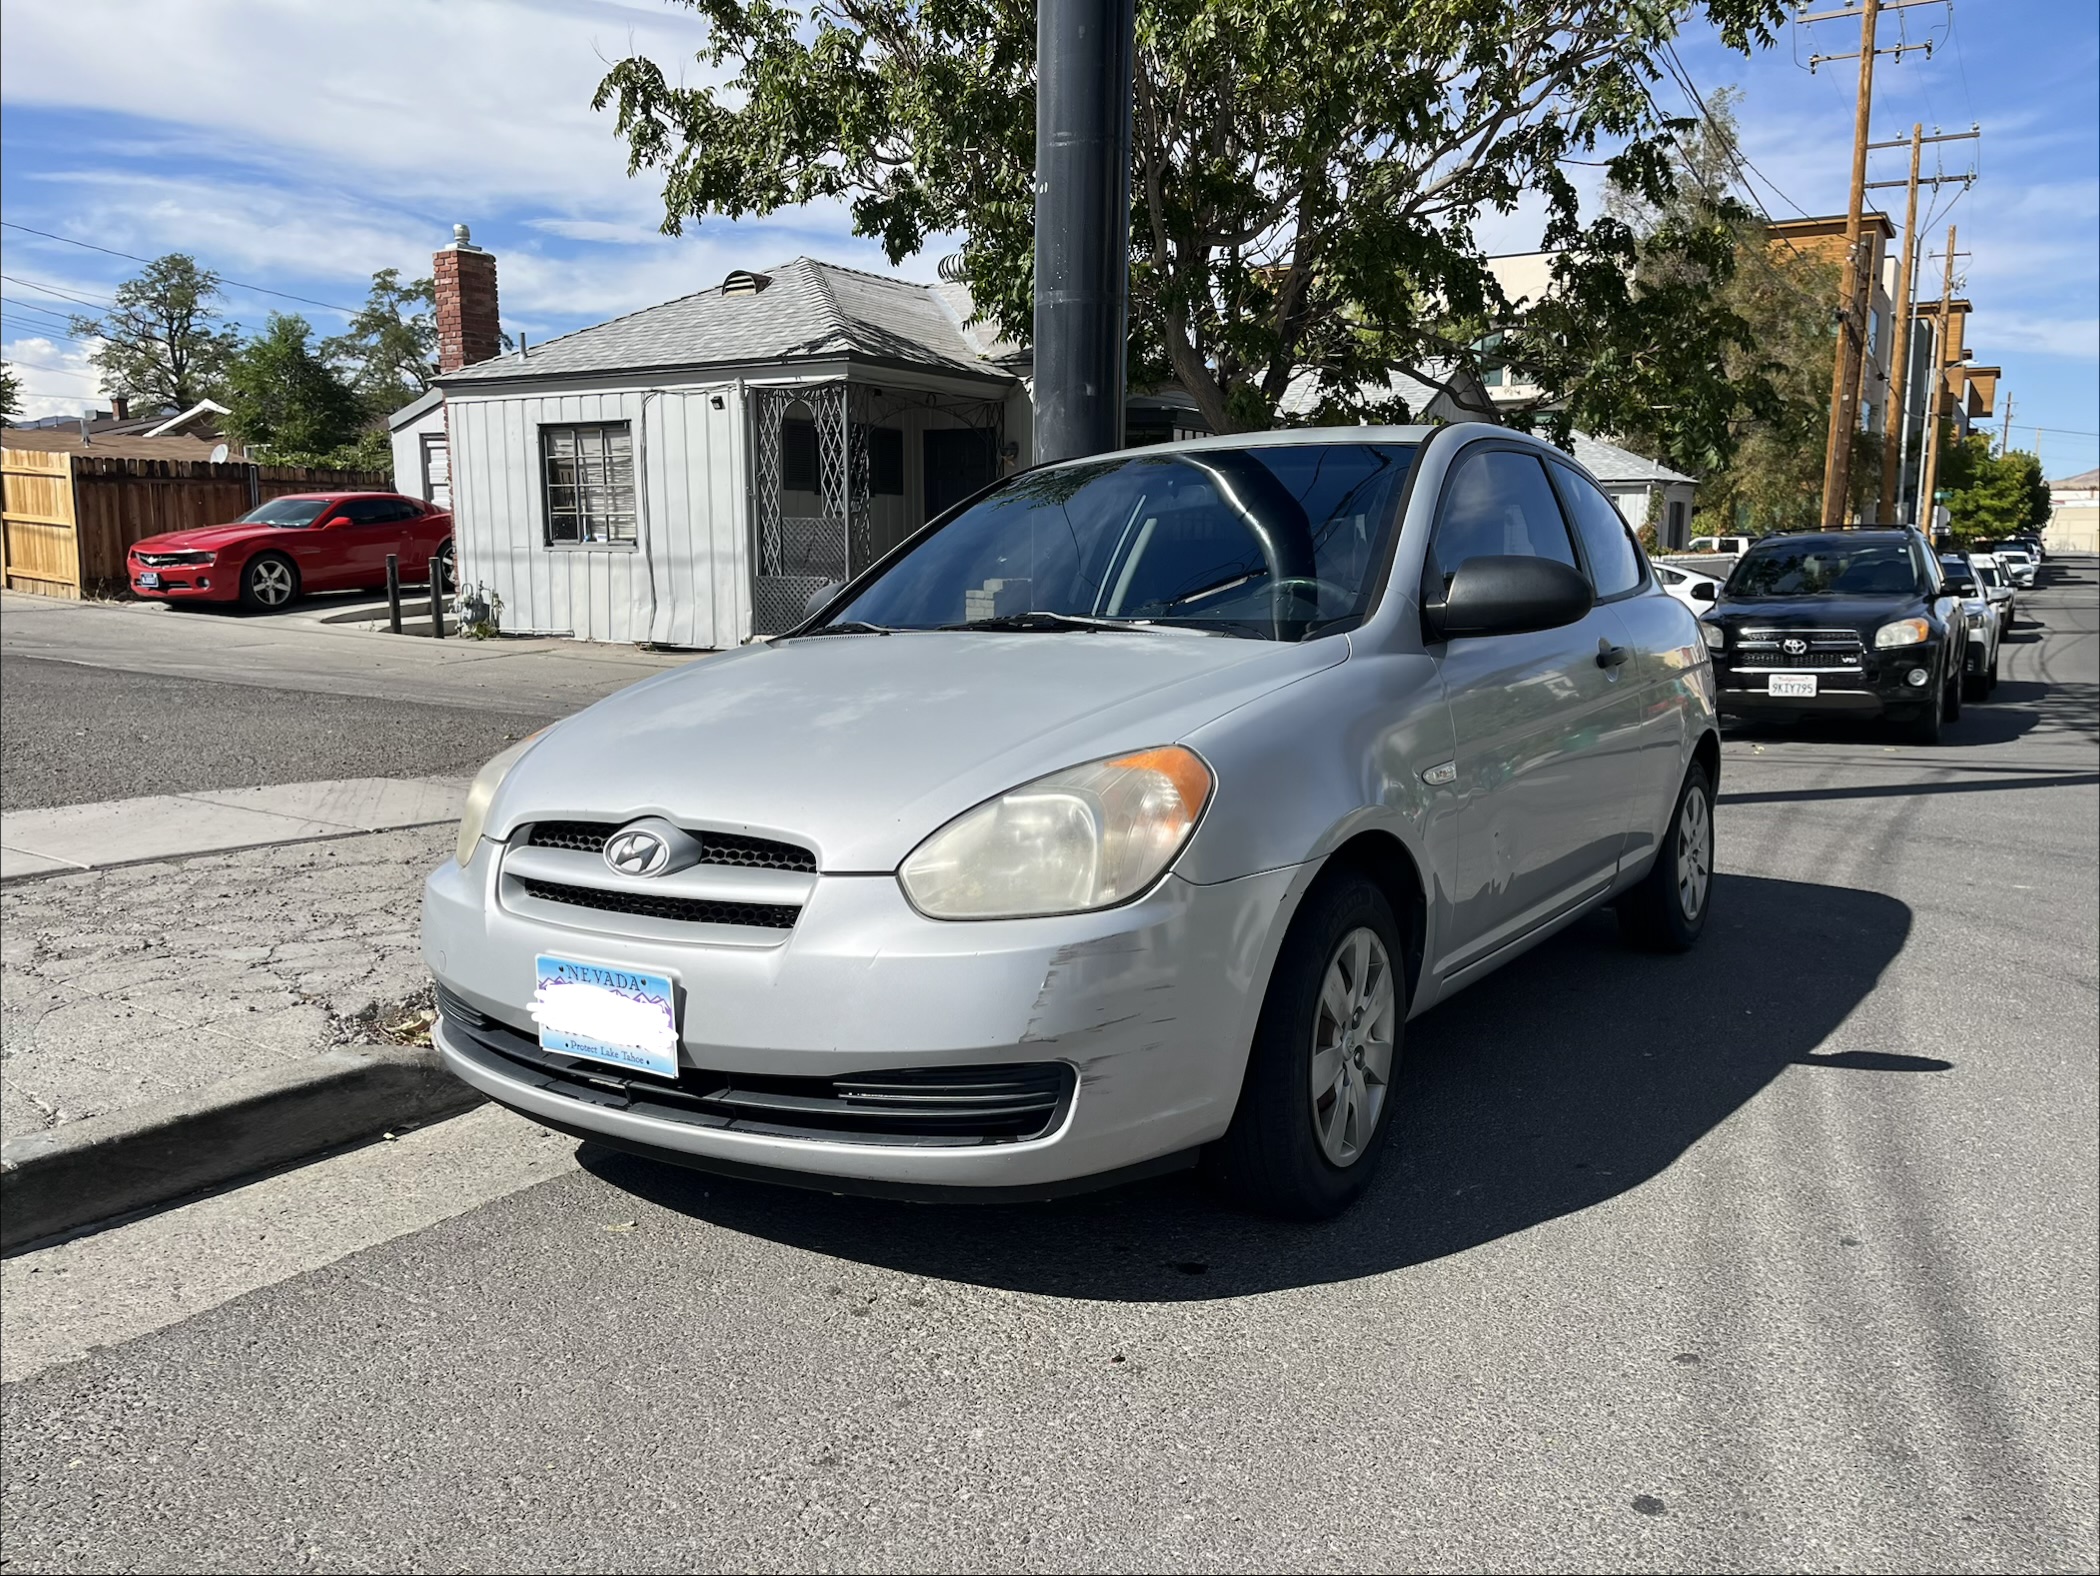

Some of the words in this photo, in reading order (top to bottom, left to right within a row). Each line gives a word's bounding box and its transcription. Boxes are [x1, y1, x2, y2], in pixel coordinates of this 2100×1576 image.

[1841, 656, 1857, 664] V6
[1772, 683, 1813, 694] 9KIY795
[565, 964, 641, 992] NEVADA
[570, 1040, 598, 1054] Protect
[600, 1046, 619, 1058] Lake
[621, 1051, 644, 1064] Tahoe
